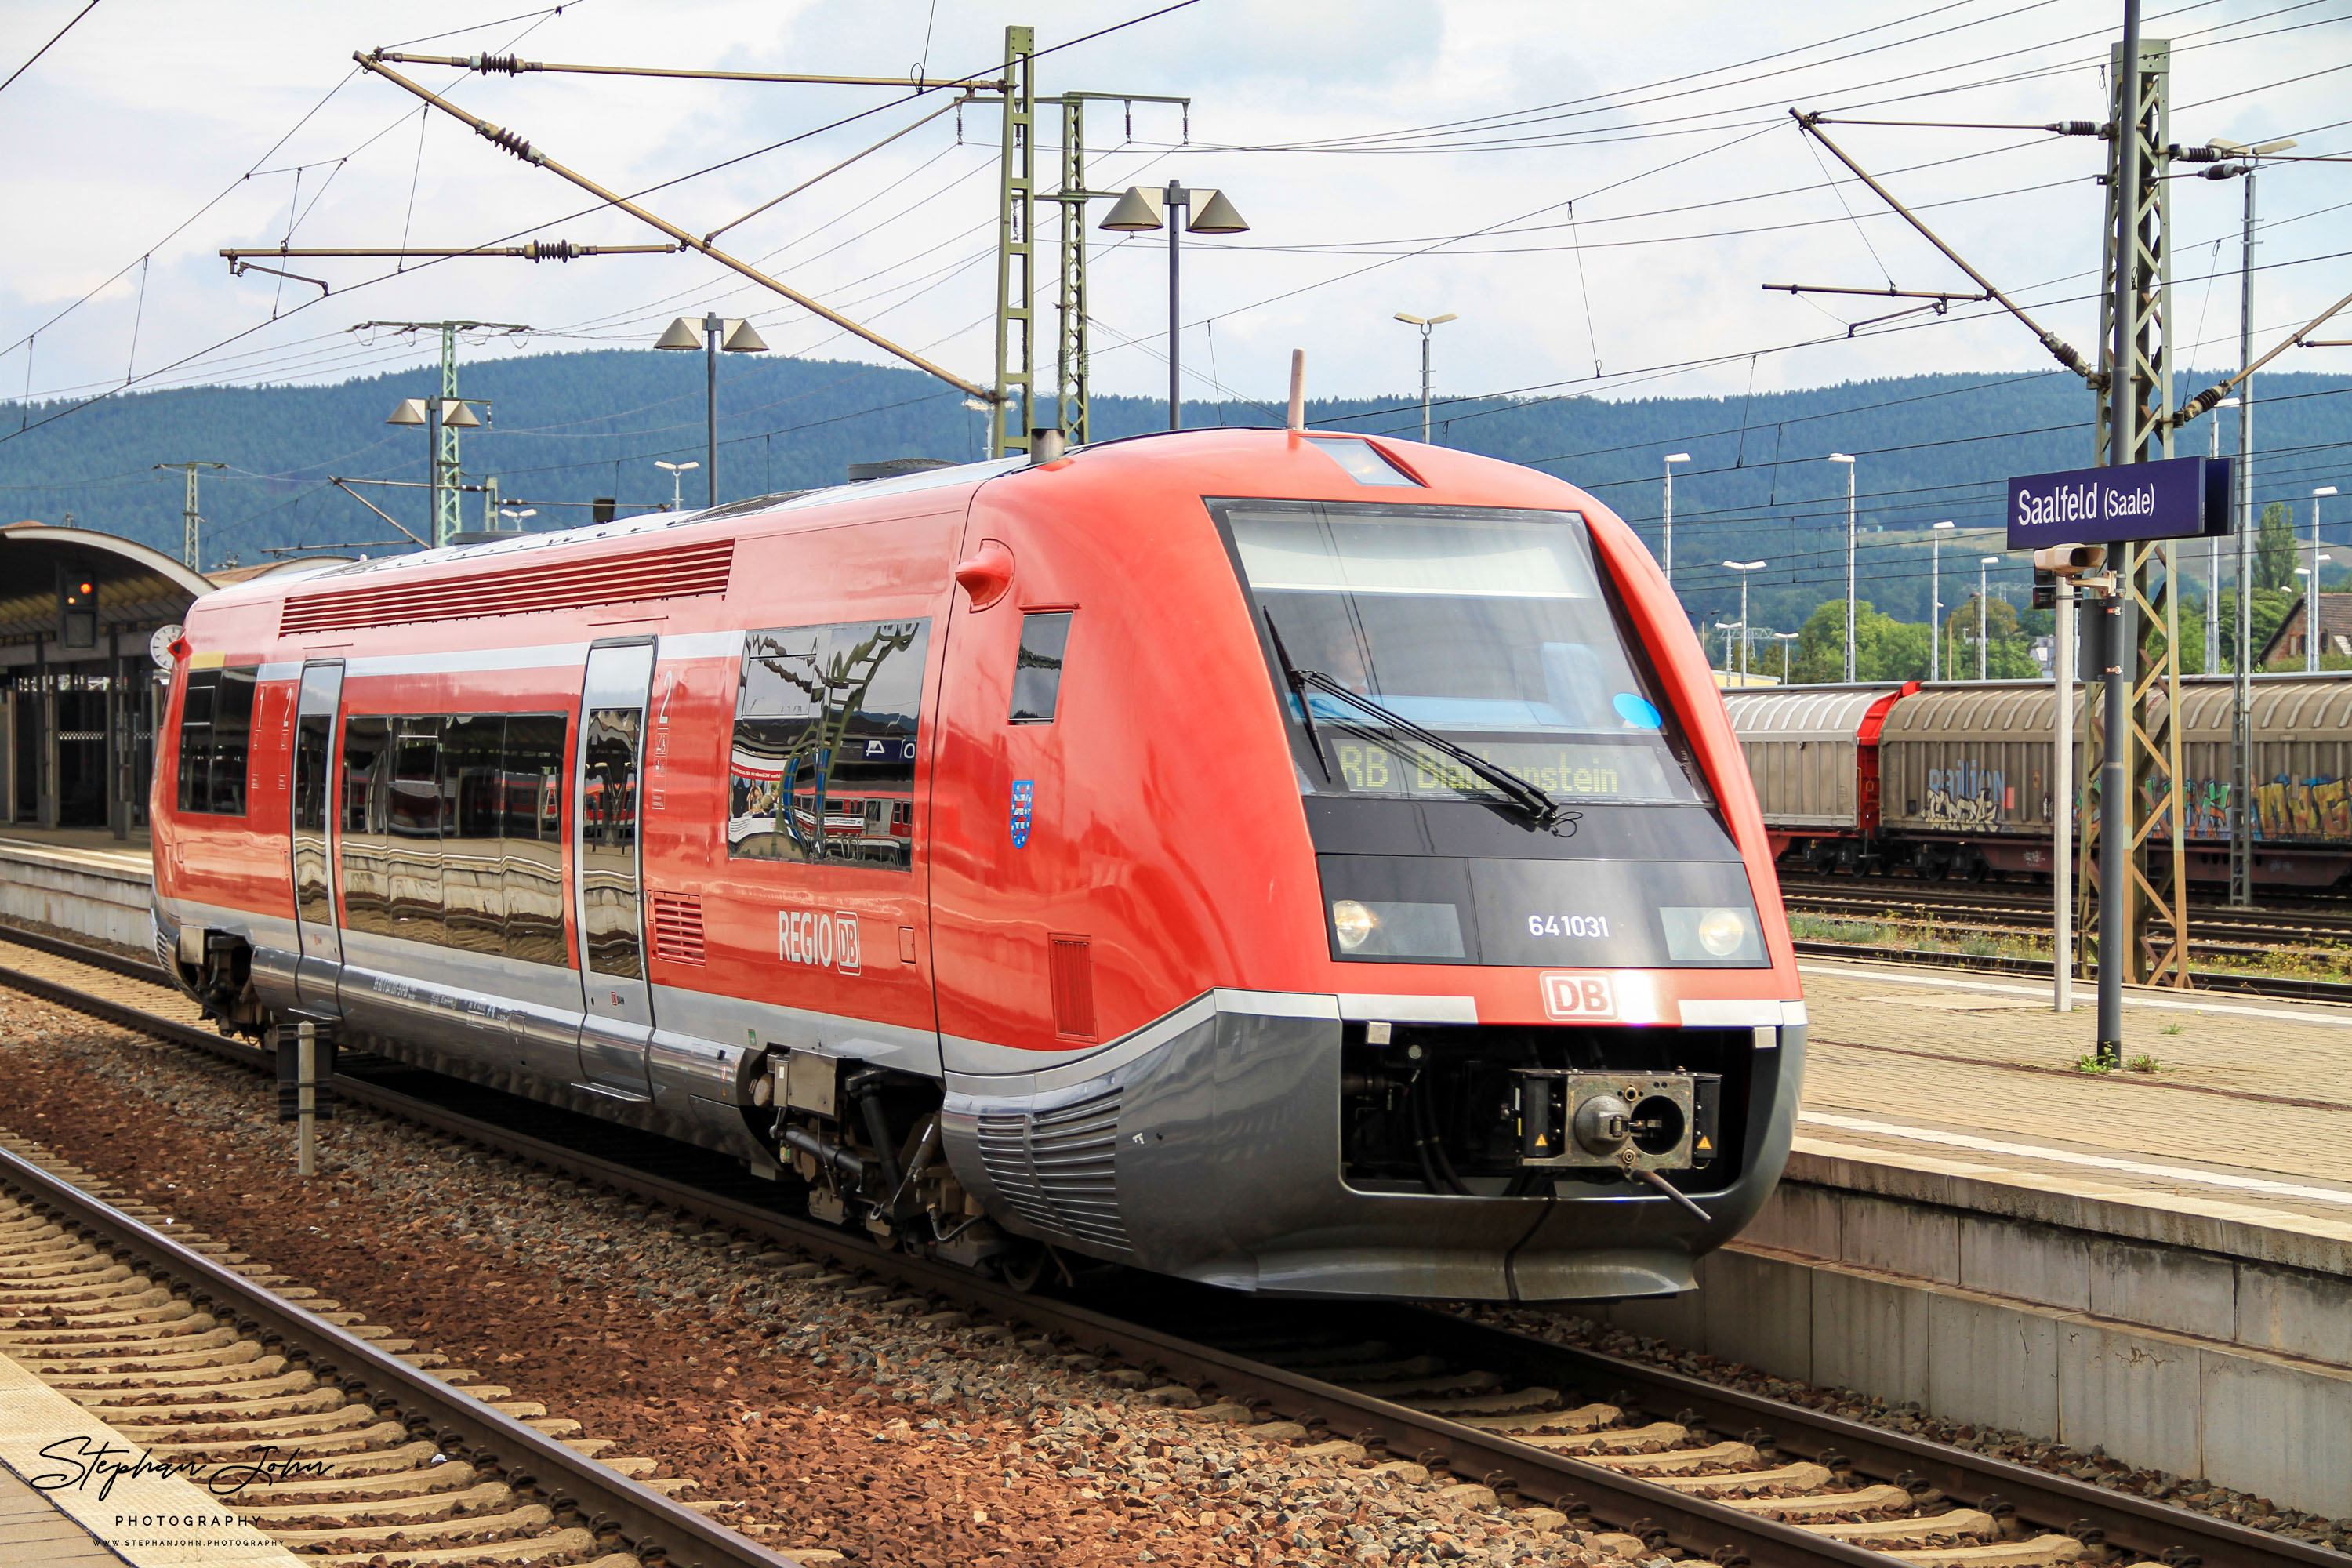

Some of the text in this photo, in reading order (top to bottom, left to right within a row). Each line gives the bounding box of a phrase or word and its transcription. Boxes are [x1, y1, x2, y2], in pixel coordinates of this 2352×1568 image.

[2018, 482, 2155, 526] Saalfeld (Saale)
[658, 670, 673, 724] 2
[1340, 746, 1388, 788] RB
[779, 910, 858, 967] REGIO DB
[1549, 977, 1612, 1014] DB
